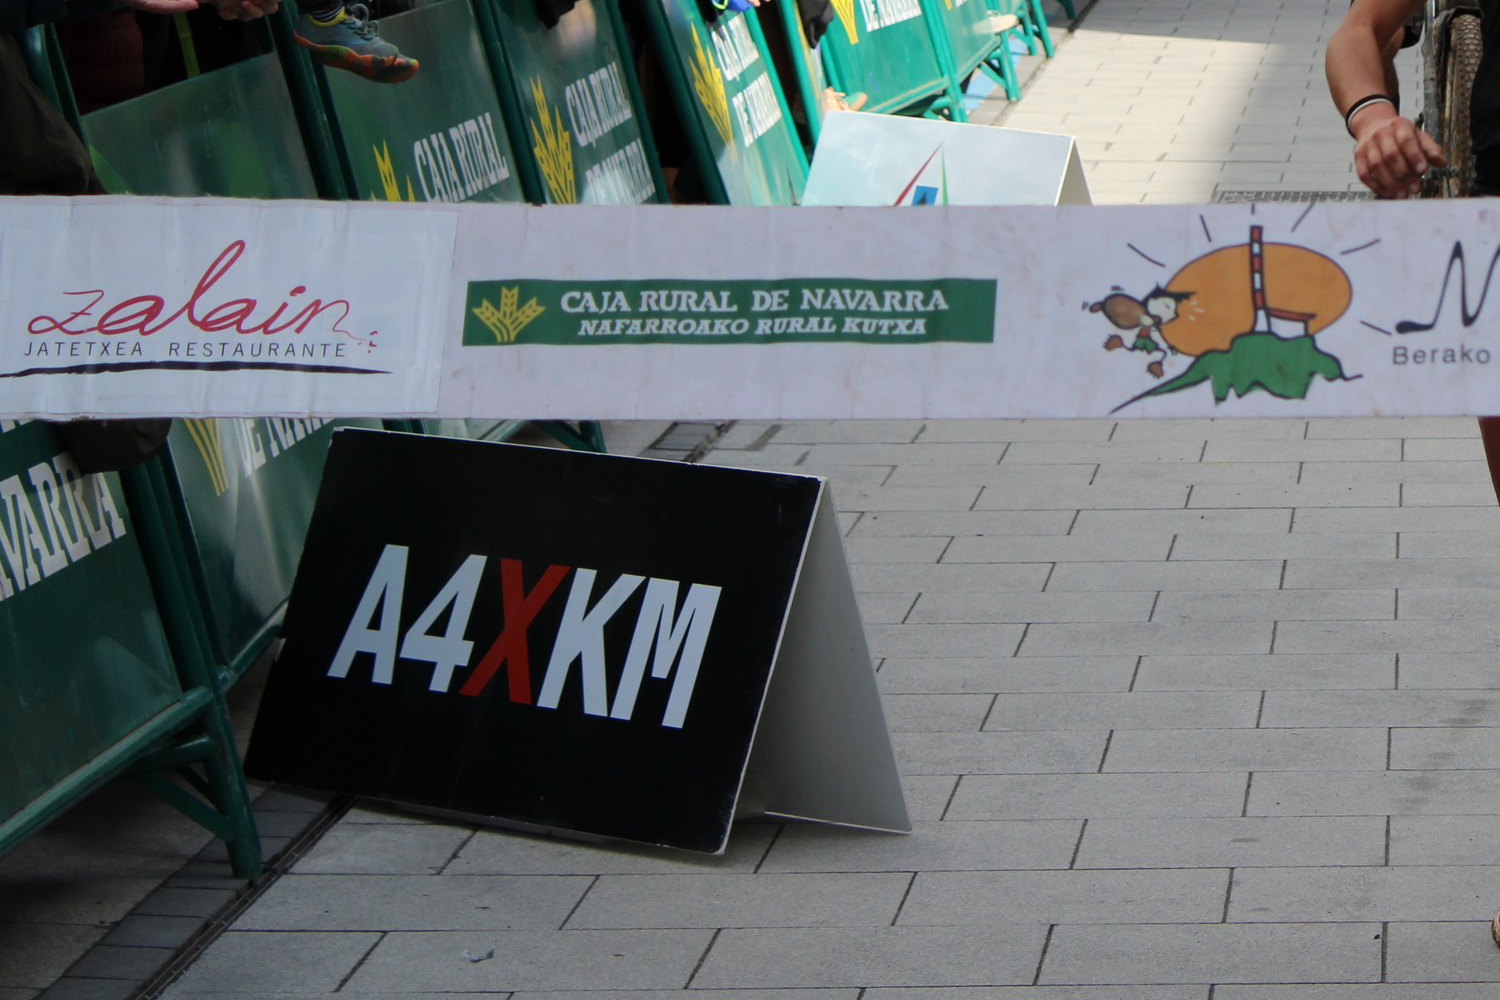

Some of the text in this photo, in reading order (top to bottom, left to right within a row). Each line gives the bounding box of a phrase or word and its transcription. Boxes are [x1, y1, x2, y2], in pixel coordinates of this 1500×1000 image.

[413, 112, 510, 202] CAJA RURAL
[560, 288, 949, 315] CAJA RURAL DE NAVARRA
[577, 318, 927, 336] NAFARROAKO RURAL KUTXA
[24, 341, 347, 358] JATETXEA RESTAURANTE
[1392, 346, 1492, 366] Berako
[327, 543, 722, 729] A4XKM
